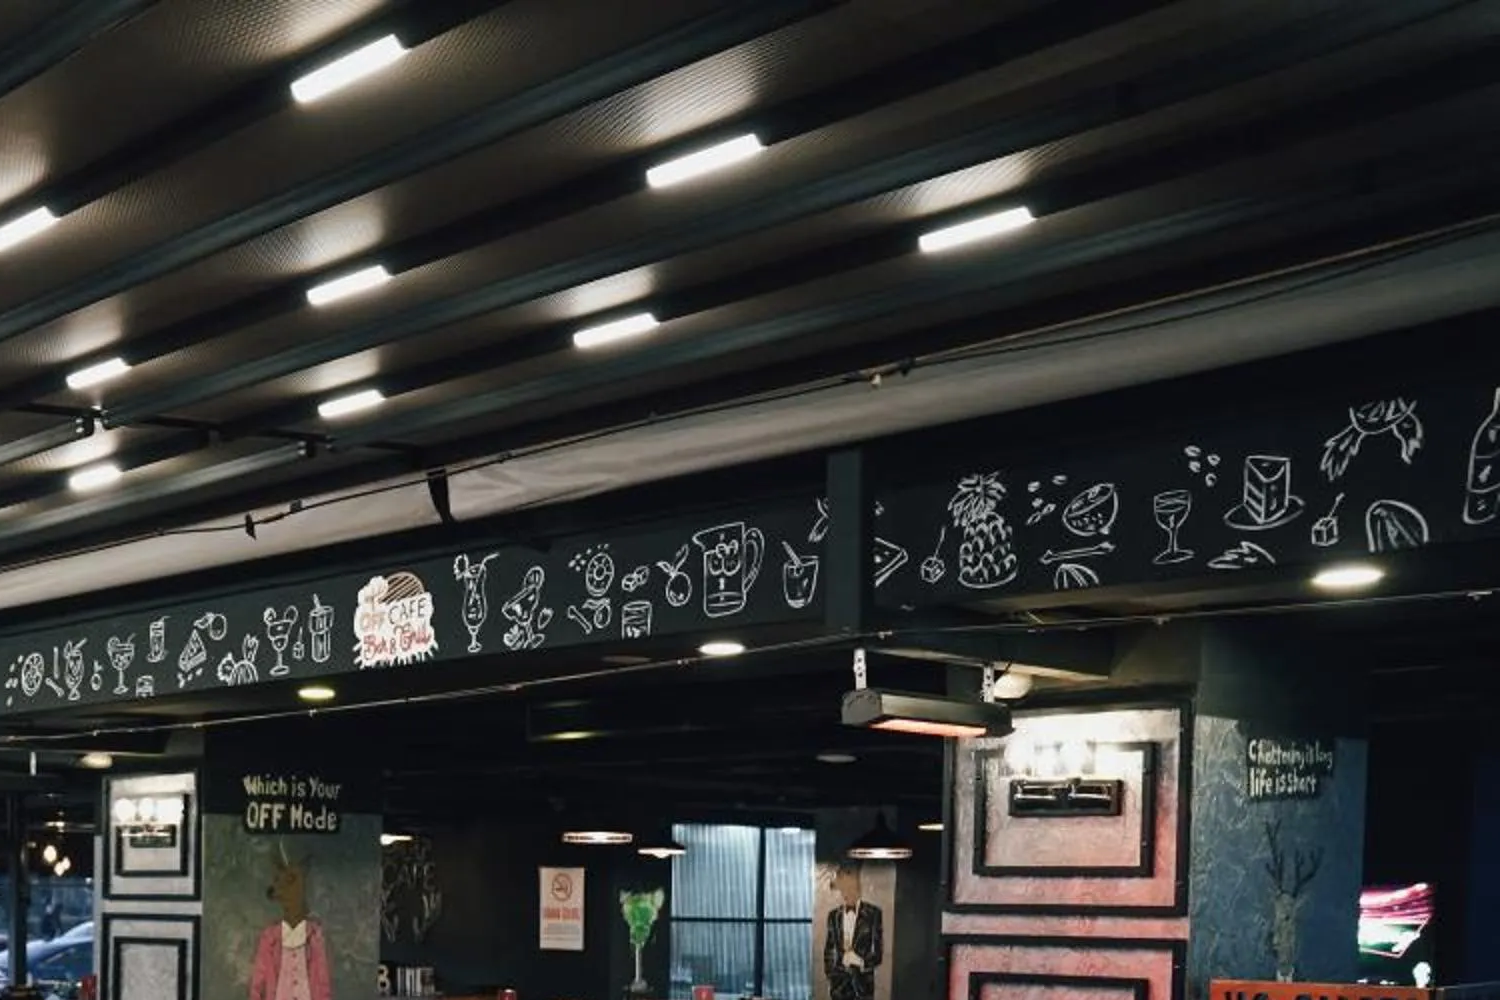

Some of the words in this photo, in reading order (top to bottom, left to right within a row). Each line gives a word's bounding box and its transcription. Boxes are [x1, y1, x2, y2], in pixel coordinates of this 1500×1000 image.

[387, 596, 427, 625] CAFE
[243, 773, 288, 796] Which
[291, 775, 306, 798] is
[308, 776, 341, 801] Your
[1250, 767, 1273, 797] life
[1275, 768, 1287, 795] is
[247, 801, 286, 830] OFF
[289, 804, 337, 832] Mode
